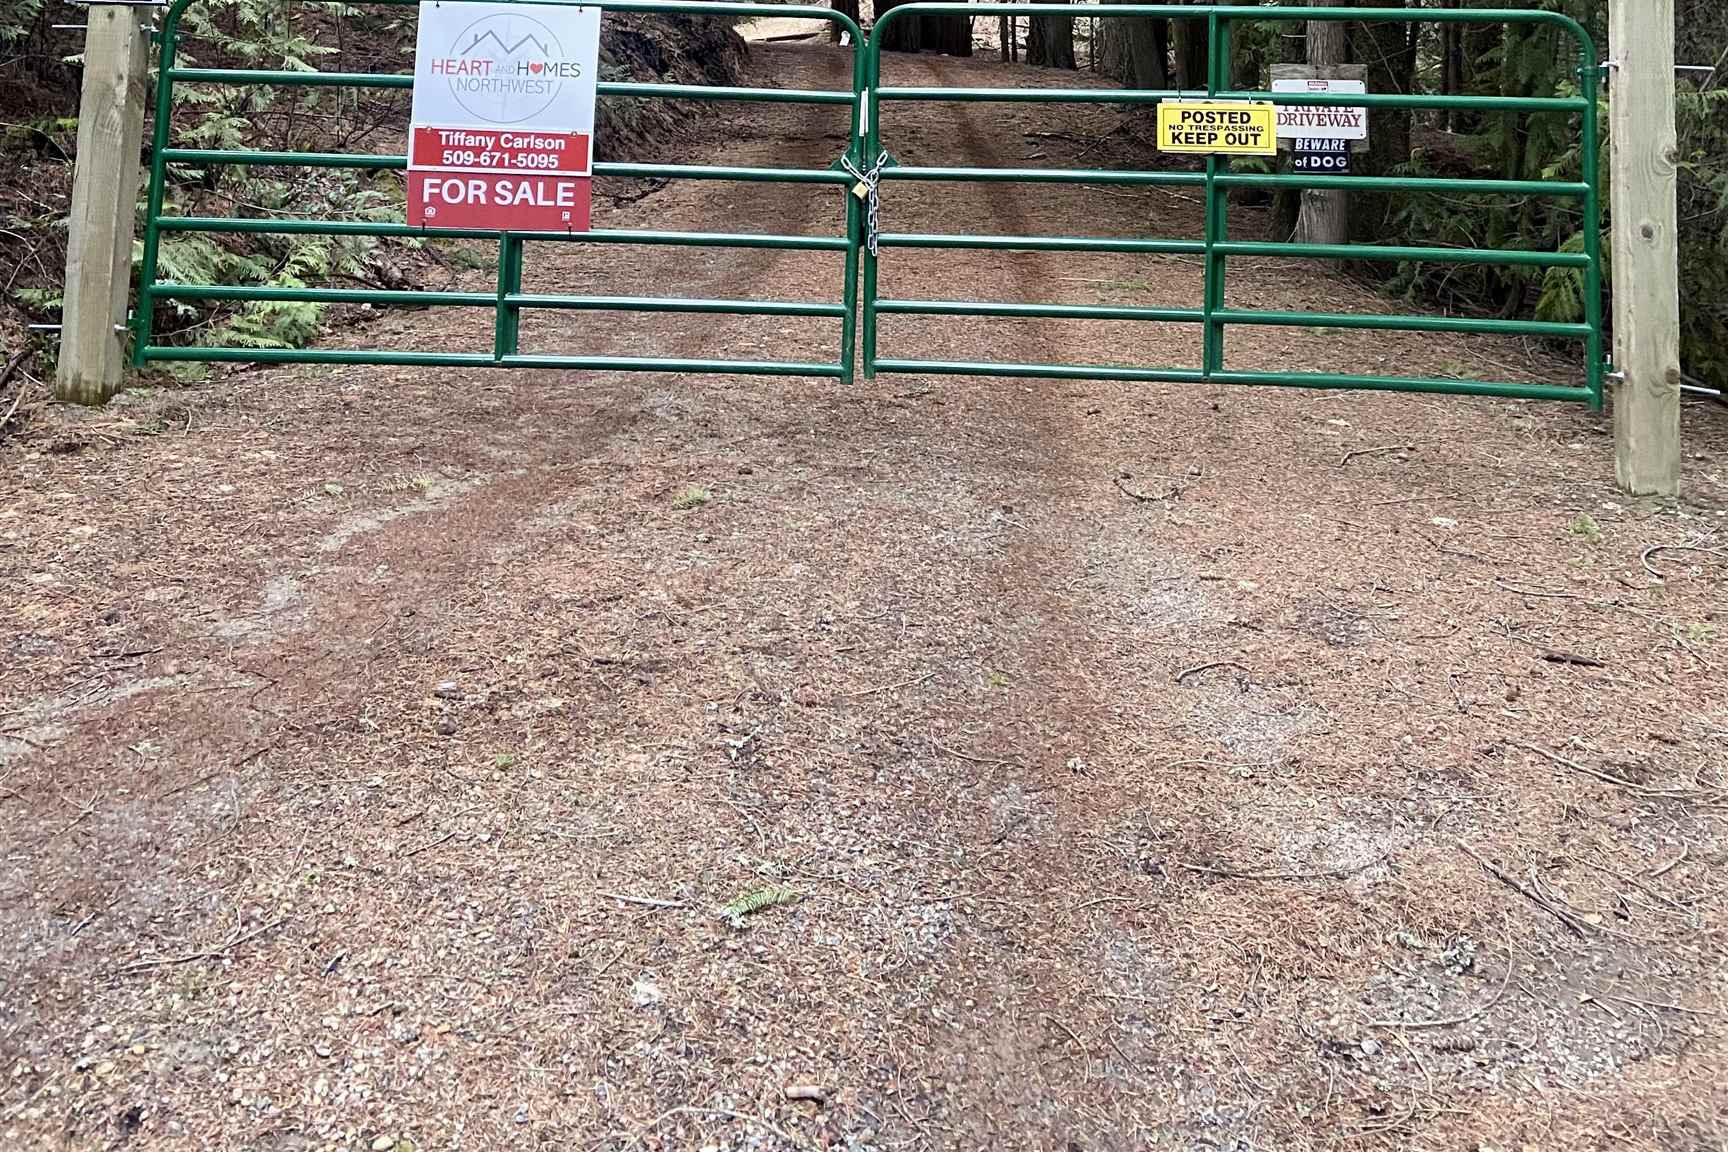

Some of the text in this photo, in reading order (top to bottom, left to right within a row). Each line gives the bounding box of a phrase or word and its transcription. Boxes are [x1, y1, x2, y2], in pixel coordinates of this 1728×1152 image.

[431, 59, 493, 76] HEART
[495, 64, 516, 75] AND
[456, 77, 554, 95] NORTHWEST
[1181, 111, 1251, 124] POSTED
[1277, 112, 1361, 128] DRIVEWAY
[1189, 124, 1265, 132] TRESPASSING
[438, 131, 565, 150] Tiffany Carlson
[1171, 132, 1262, 146] KEEP OUT
[1295, 138, 1346, 151] BEWARE
[442, 150, 559, 169] 509-671-5095
[1294, 156, 1347, 168] of DOG
[422, 178, 576, 207] FOR SALE
